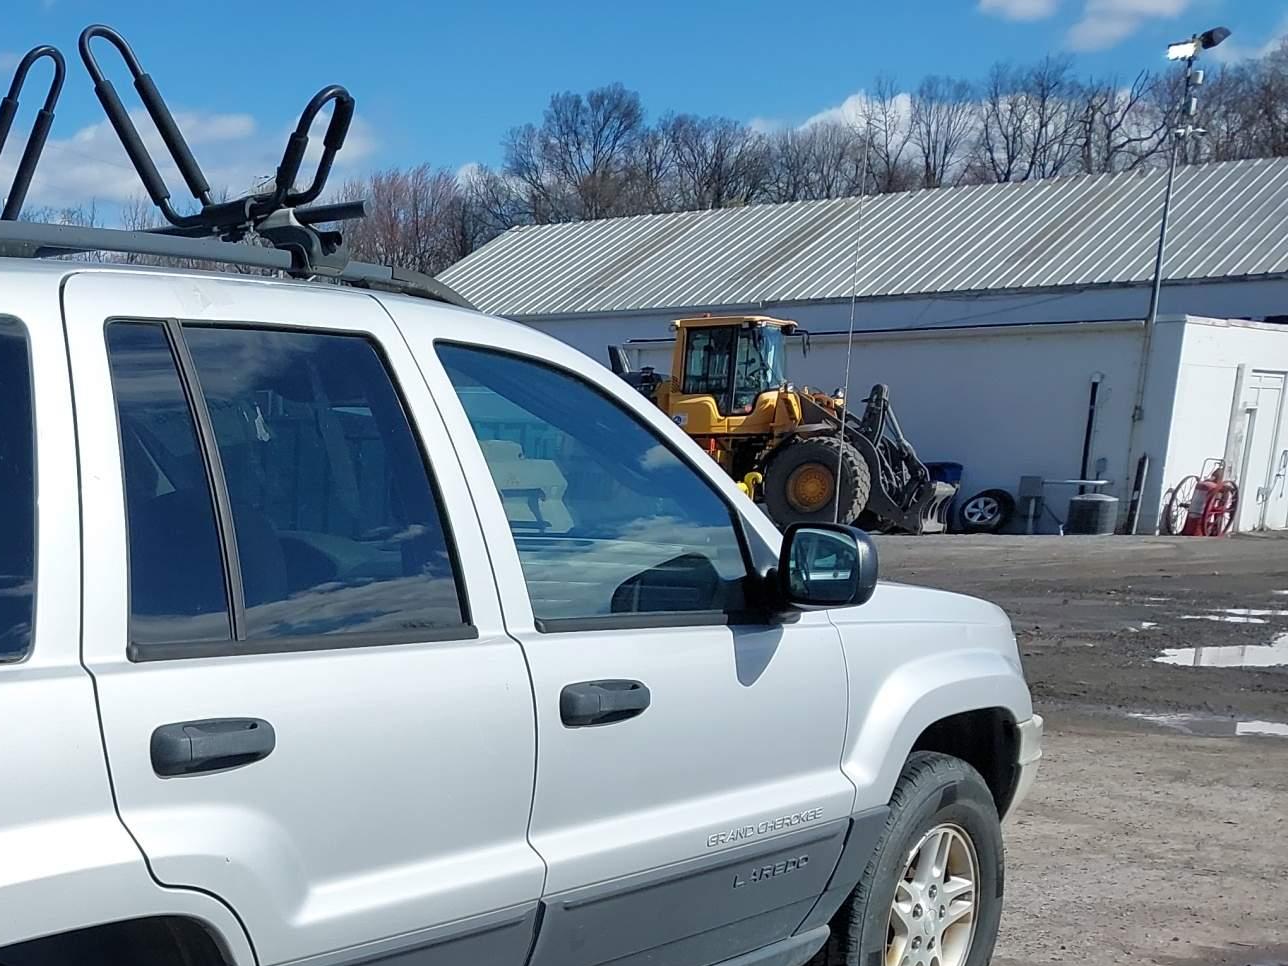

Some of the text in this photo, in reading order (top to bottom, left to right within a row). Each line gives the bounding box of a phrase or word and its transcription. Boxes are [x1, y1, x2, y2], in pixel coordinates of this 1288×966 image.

[706, 806, 824, 848] GRAND CHEROKEE
[732, 854, 809, 889] LAREDO
